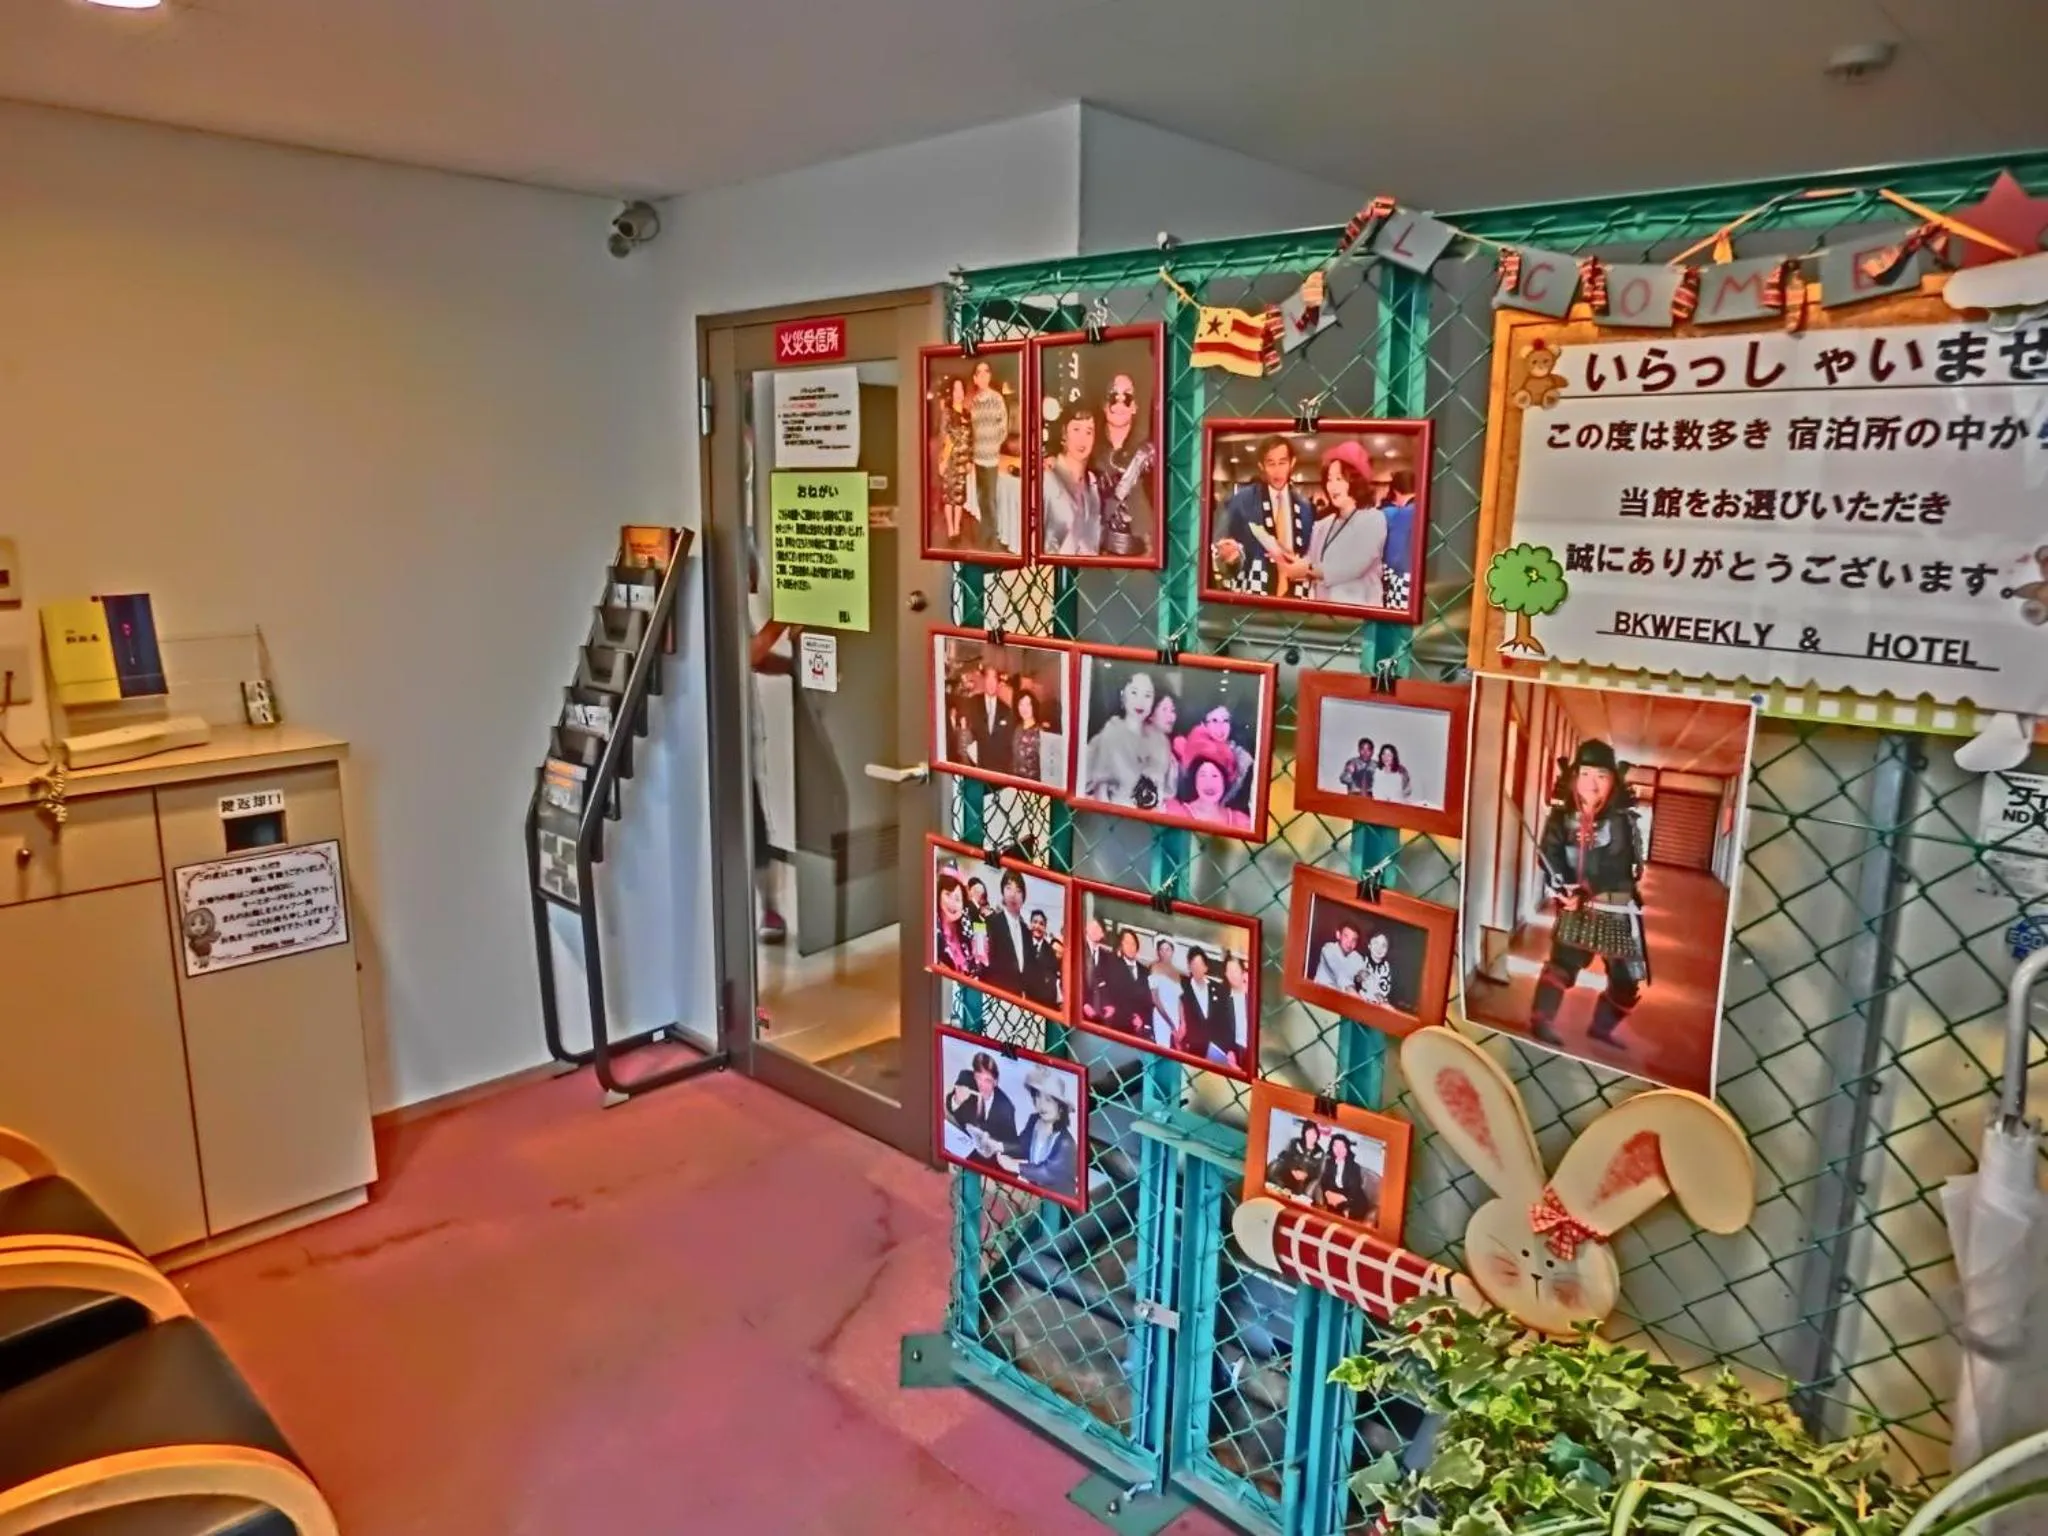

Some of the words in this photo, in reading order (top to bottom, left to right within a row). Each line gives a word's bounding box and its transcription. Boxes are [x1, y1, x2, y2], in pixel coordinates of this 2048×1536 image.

[1787, 413, 2048, 452] 宿泊所の中か
[797, 485, 840, 499] おねがい
[1619, 487, 1952, 524] 当館をお選びいただき
[1566, 543, 2014, 599] 誠にありがとうございます。
[1614, 612, 1774, 648] BKWEEKLY
[1799, 627, 1822, 651] &
[1867, 632, 1979, 668] HOTEL
